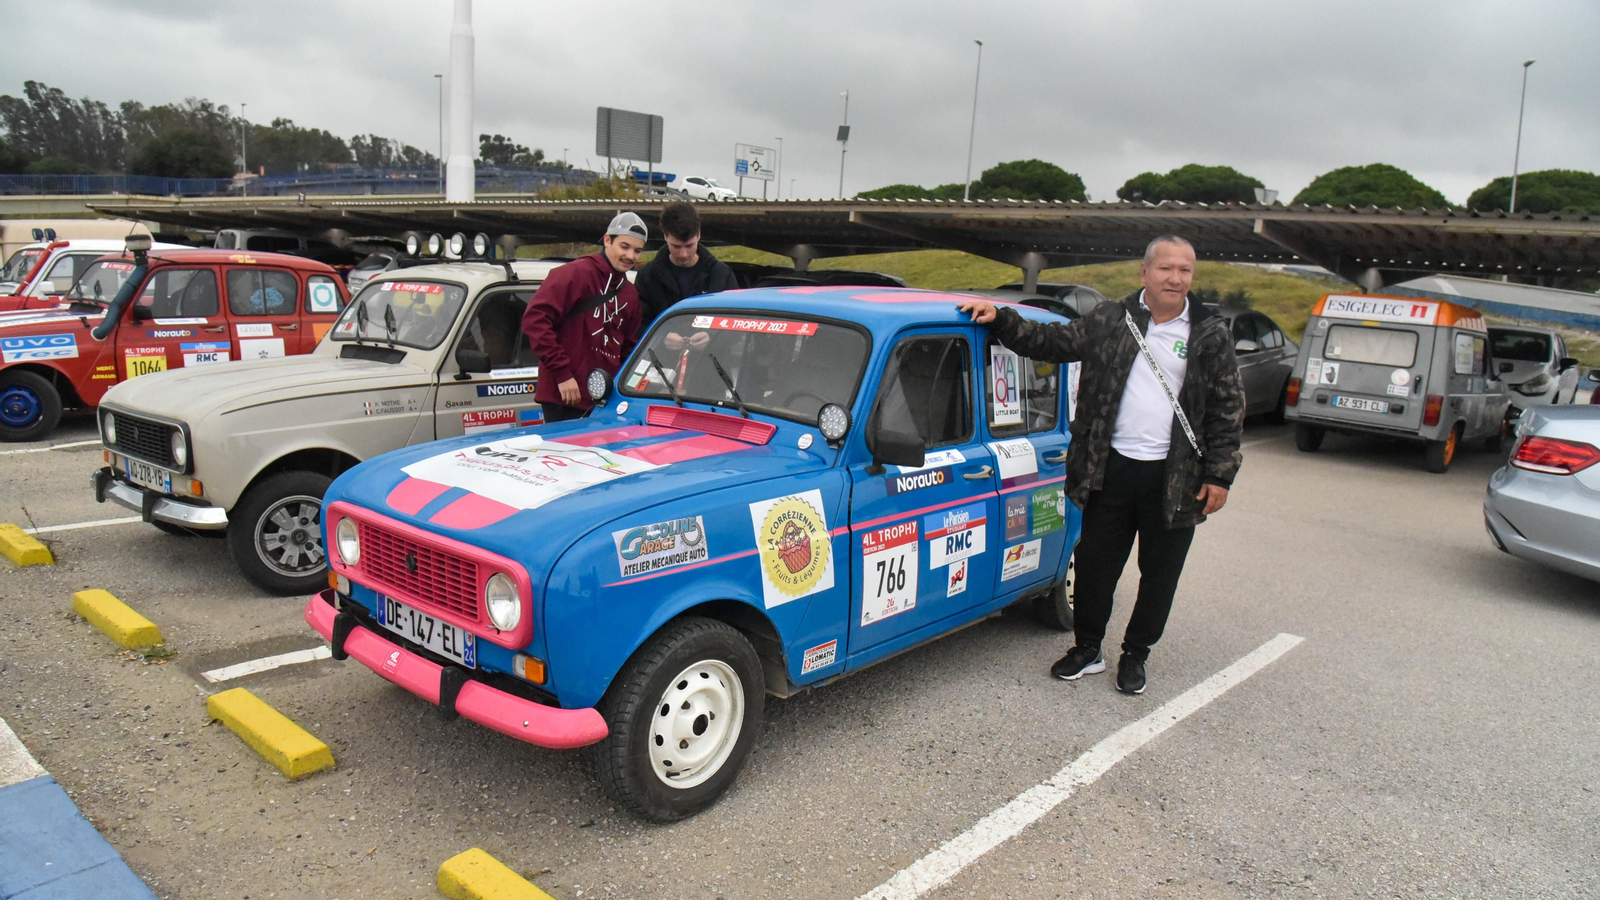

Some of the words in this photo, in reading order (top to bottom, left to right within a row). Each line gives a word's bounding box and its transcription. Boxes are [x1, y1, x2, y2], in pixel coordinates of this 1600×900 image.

[1327, 300, 1404, 316] ESIGELEC
[719, 318, 728, 328] 4L
[732, 320, 767, 330] TROPHY
[767, 322, 788, 332] 2023
[154, 330, 192, 338] Norauto
[5, 337, 71, 348] UVO
[196, 353, 218, 362] RMC
[487, 383, 535, 396] Norauto
[638, 380, 646, 390] F
[445, 400, 473, 408] Savane
[1009, 408, 1020, 416] BOAT
[464, 413, 476, 422] 4L
[477, 409, 514, 420] TROPHY
[500, 463, 531, 476] plus
[532, 472, 558, 484] loin
[896, 470, 944, 493] Norauto
[770, 510, 817, 535] CORRÉZIENNE
[948, 510, 970, 527] Parisien
[620, 516, 697, 560] GASOLINE
[863, 533, 876, 546] 4L
[878, 520, 917, 542] TROPHY
[767, 538, 776, 551] LA
[946, 530, 972, 556] RMC
[623, 560, 650, 576] ATELIER
[689, 548, 706, 560] AUTO
[773, 563, 792, 585] Fruits
[793, 576, 798, 585] &
[800, 545, 822, 583] Légumes
[876, 554, 906, 598] 766
[950, 560, 965, 588] NRJ
[882, 606, 898, 616] EDITION
[390, 650, 400, 662] 4L
[464, 648, 474, 664] 24
